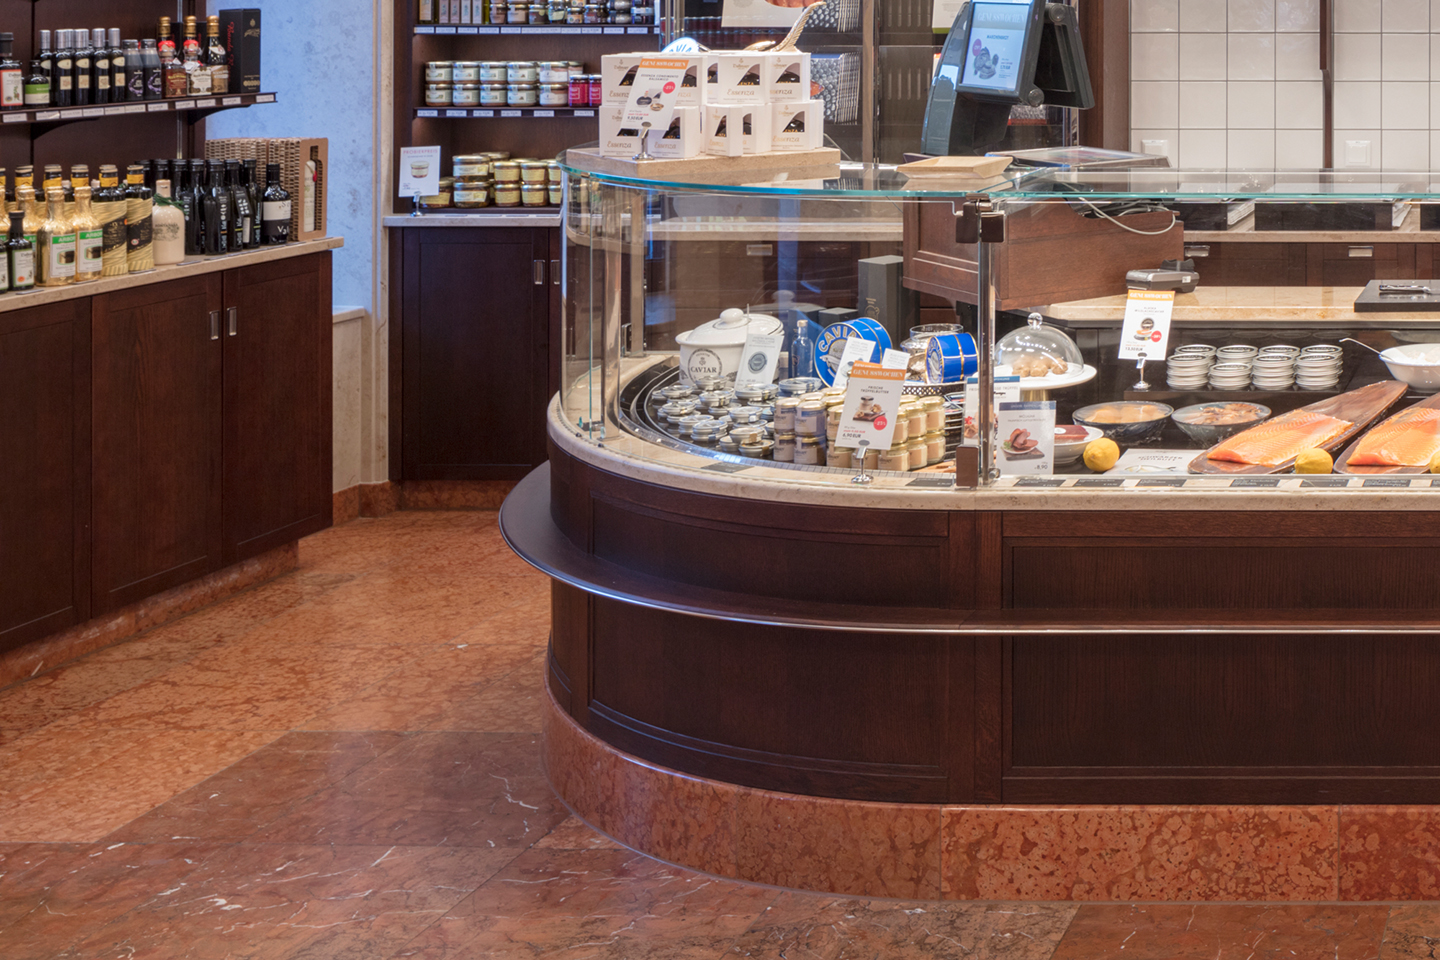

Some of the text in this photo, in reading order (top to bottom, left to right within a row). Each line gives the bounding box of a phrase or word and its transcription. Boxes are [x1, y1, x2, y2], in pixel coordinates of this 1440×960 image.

[642, 59, 686, 67] GENUSSWOCHEN
[609, 90, 629, 98] Essenz
[607, 140, 632, 149] Essenza
[818, 326, 857, 352] CAVIA
[853, 369, 904, 378] GENUSSWOCHEN
